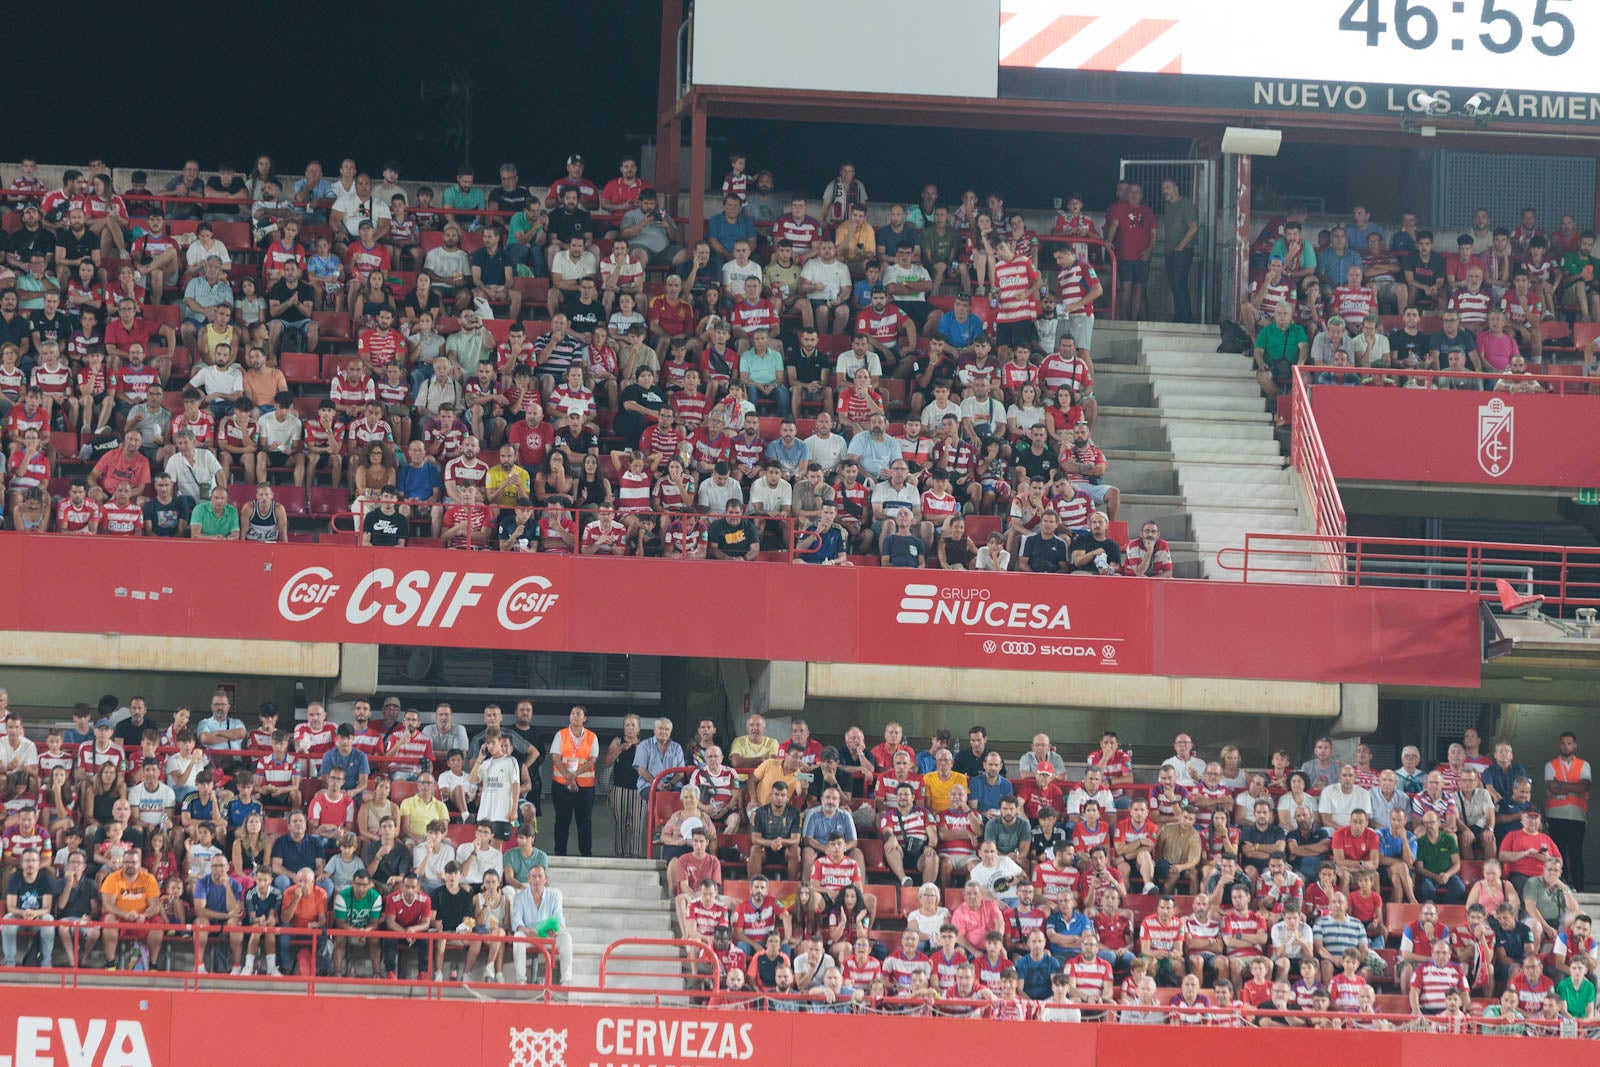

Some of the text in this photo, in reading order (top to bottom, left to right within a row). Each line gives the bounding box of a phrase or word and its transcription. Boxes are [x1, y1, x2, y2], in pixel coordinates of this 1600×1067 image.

[1338, 0, 1576, 57] 46:55
[1253, 82, 1367, 110] NUEVO
[1387, 87, 1451, 113] LOS
[290, 583, 340, 604] CSIF
[345, 567, 495, 628] CSIF
[508, 592, 560, 613] CSIF
[941, 587, 991, 601] GRUPO
[933, 600, 1071, 630] NUCESA
[0, 1016, 153, 1067] EVA
[595, 1017, 754, 1061] CERVEZAS
